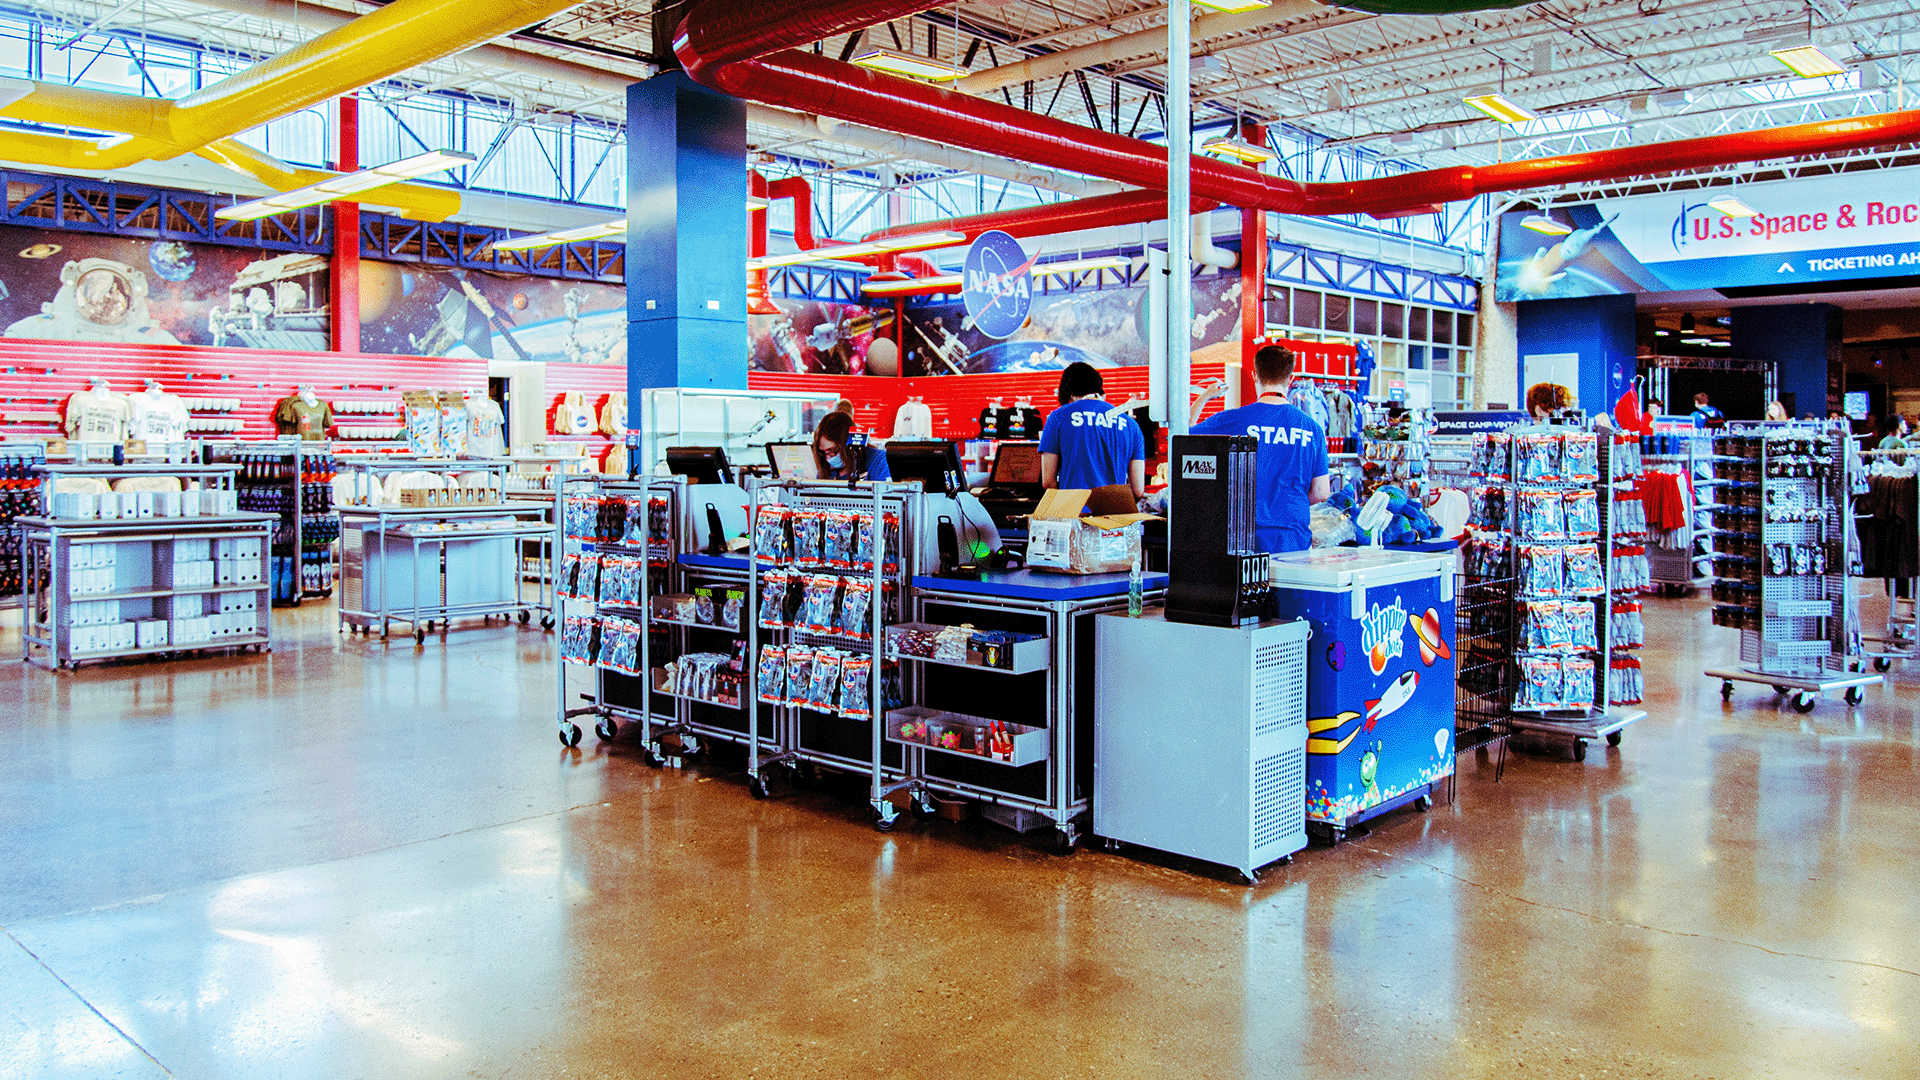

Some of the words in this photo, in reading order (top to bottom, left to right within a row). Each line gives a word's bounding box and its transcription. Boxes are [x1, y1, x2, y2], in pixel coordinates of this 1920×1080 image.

[1694, 215, 1742, 241] U.S.
[1750, 211, 1828, 240] Space
[1836, 204, 1857, 229] &
[1867, 198, 1920, 226] Roc
[1807, 254, 1895, 272] TICKETING
[1898, 251, 1920, 266] AH
[969, 268, 1030, 299] NASA
[1071, 411, 1127, 431] STAFF
[1439, 420, 1468, 429] SPACE
[1468, 420, 1492, 429] CAMP
[1493, 420, 1519, 429] VINTA
[1246, 425, 1314, 447] STAFF
